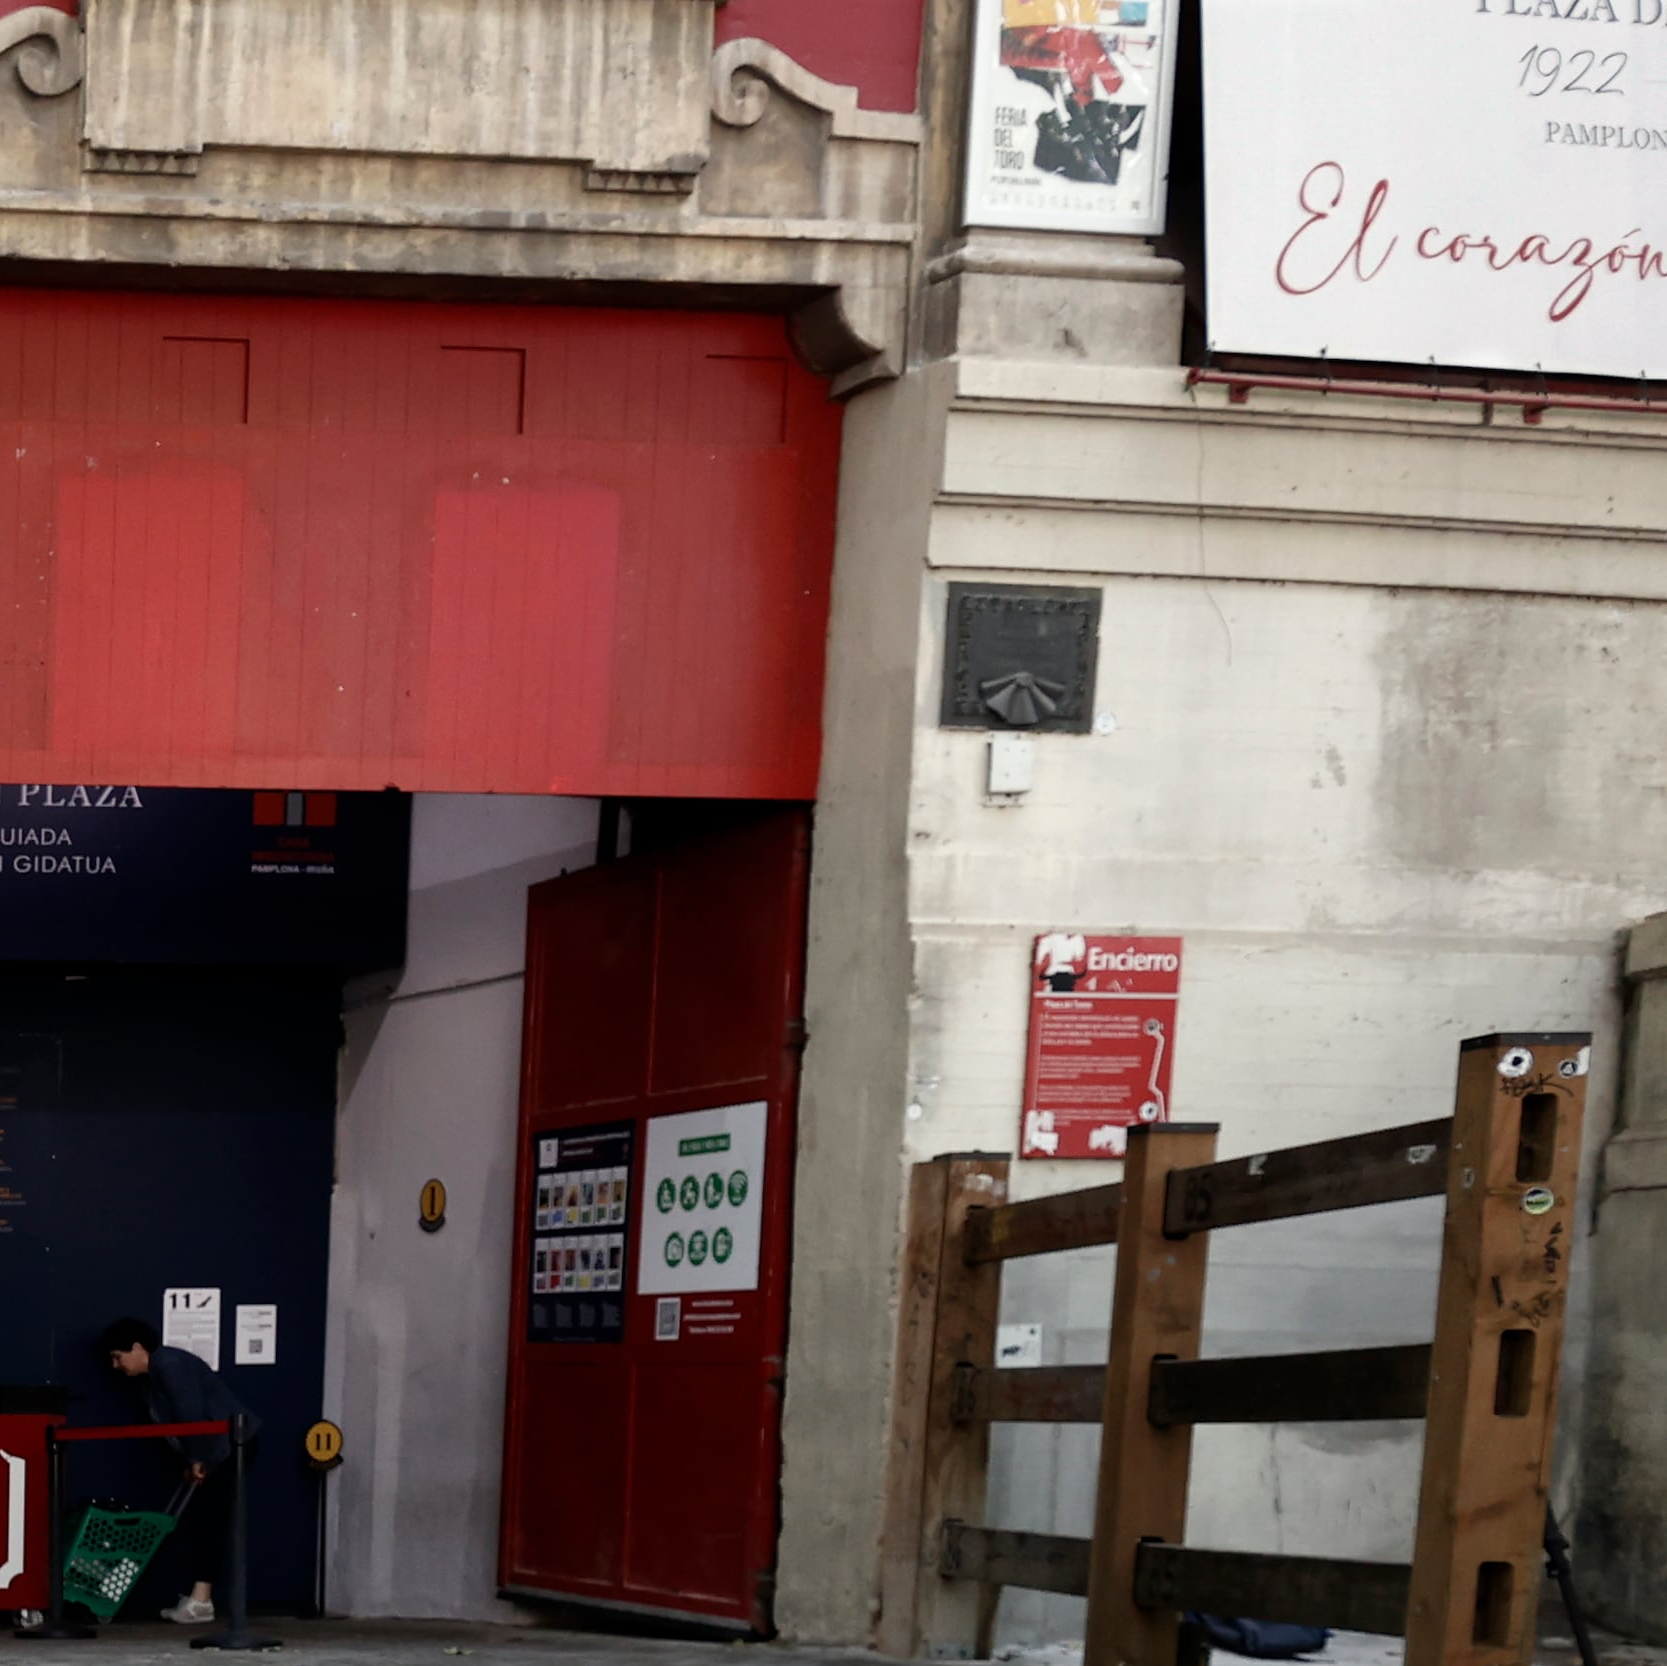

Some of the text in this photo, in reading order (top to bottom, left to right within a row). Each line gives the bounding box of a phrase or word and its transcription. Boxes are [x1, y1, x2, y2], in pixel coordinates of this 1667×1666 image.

[1519, 44, 1628, 97] 1922
[995, 106, 1027, 126] FERIA
[994, 128, 1014, 148] DEL
[993, 149, 1025, 170] TORO
[1275, 161, 1399, 295] El
[16, 785, 144, 808] PLAZA
[12, 855, 117, 874] GIDATUA
[1087, 946, 1179, 972] Encierro
